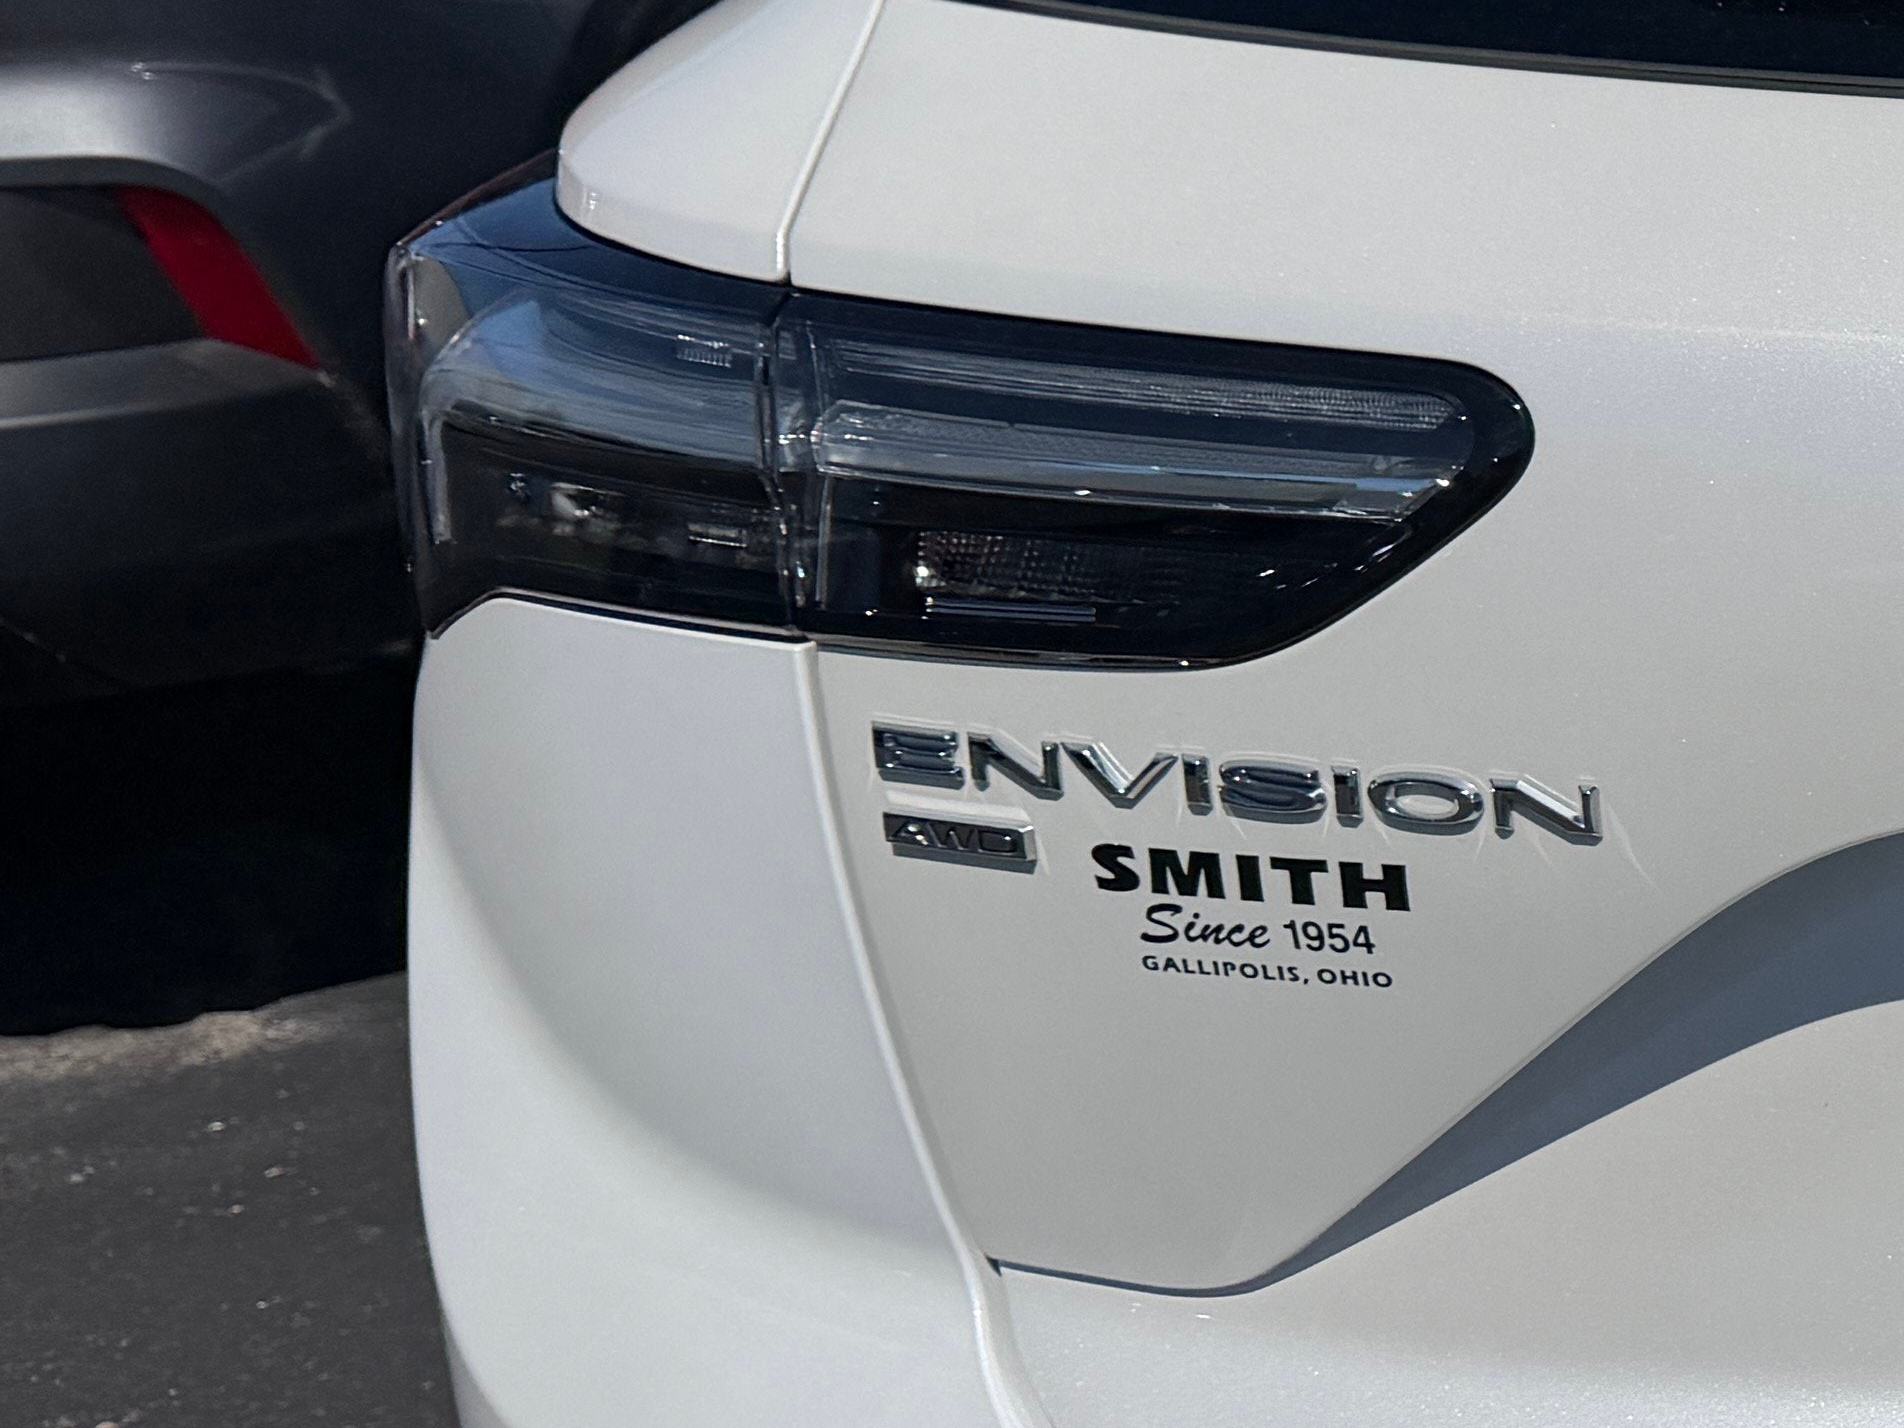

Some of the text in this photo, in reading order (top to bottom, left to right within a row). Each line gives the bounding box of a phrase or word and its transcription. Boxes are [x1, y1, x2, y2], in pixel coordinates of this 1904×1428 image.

[872, 722, 1603, 847] ENVISION
[888, 817, 1028, 863] AWD
[1091, 843, 1411, 912] SMITH
[1140, 903, 1376, 955] Since 1954
[1142, 954, 1393, 988] GALLIPOLIS, OHIO
